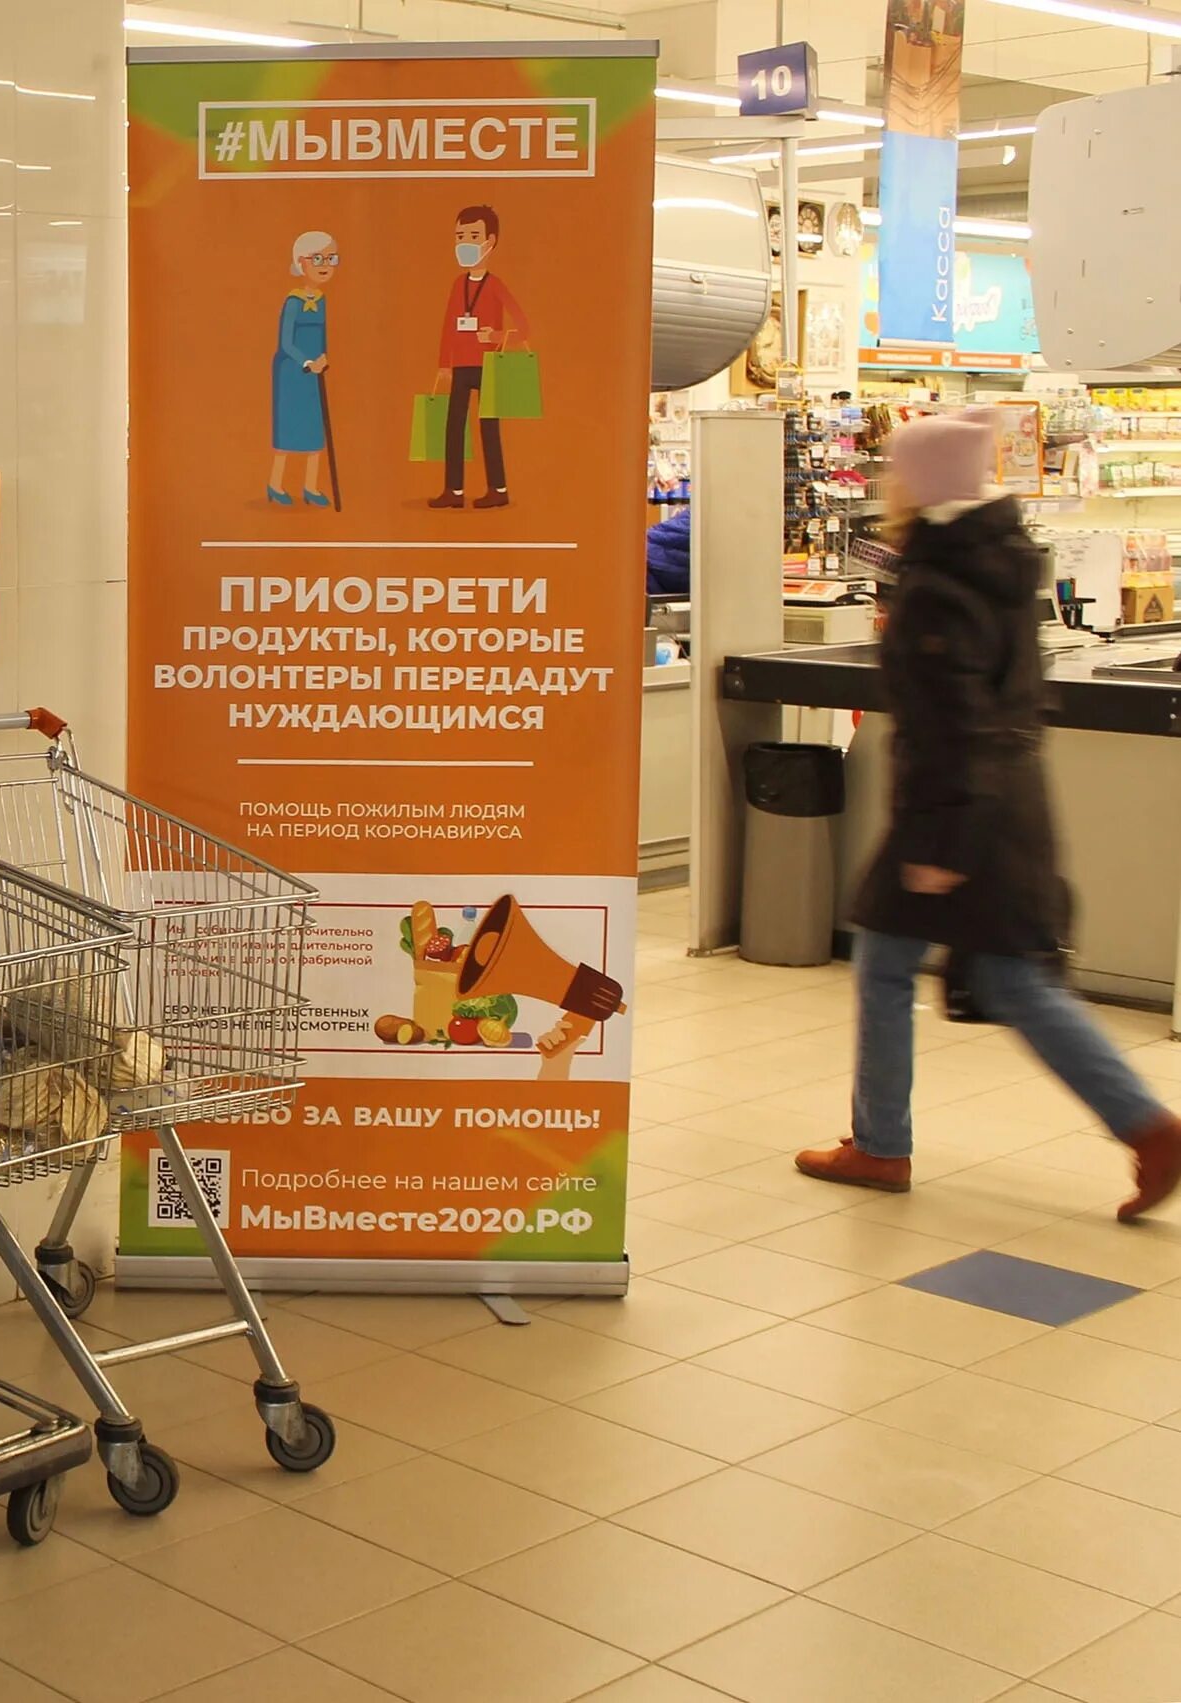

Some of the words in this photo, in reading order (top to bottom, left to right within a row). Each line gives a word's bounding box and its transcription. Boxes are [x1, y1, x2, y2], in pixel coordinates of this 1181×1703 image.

[750, 65, 792, 101] 10
[215, 117, 579, 161] #МЫВМЕСТЕ
[220, 576, 548, 614] ПРИОБРЕТИ
[183, 626, 396, 656] ПРОДУКТЫ,
[408, 628, 584, 653] КОТОРЫЕ
[154, 664, 381, 690] ВОЛОНТЕРЫ
[394, 667, 614, 695] ПЕРЕДАДУТ
[228, 703, 545, 733] НУЖДАЮЩИМСЯ
[240, 802, 332, 819] ПОМОЩЬ
[337, 803, 444, 818] ПОЖИЛЫМ
[450, 804, 525, 820] ЛЮДЯМ
[247, 823, 274, 837] НА
[279, 823, 360, 840] ПЕРИОД
[365, 824, 523, 839] КОРОНАВИРУСА
[290, 941, 373, 952] дительного
[304, 1106, 341, 1126] ЗА
[354, 1107, 443, 1128] ВАШУ
[454, 1108, 601, 1132] ПОМОЩЬ!
[241, 1169, 387, 1193] Подробнее
[395, 1174, 424, 1190] на
[432, 1175, 518, 1192] нашем
[526, 1172, 597, 1193] сайте
[241, 1205, 593, 1235] МыВместе2020.РФ
